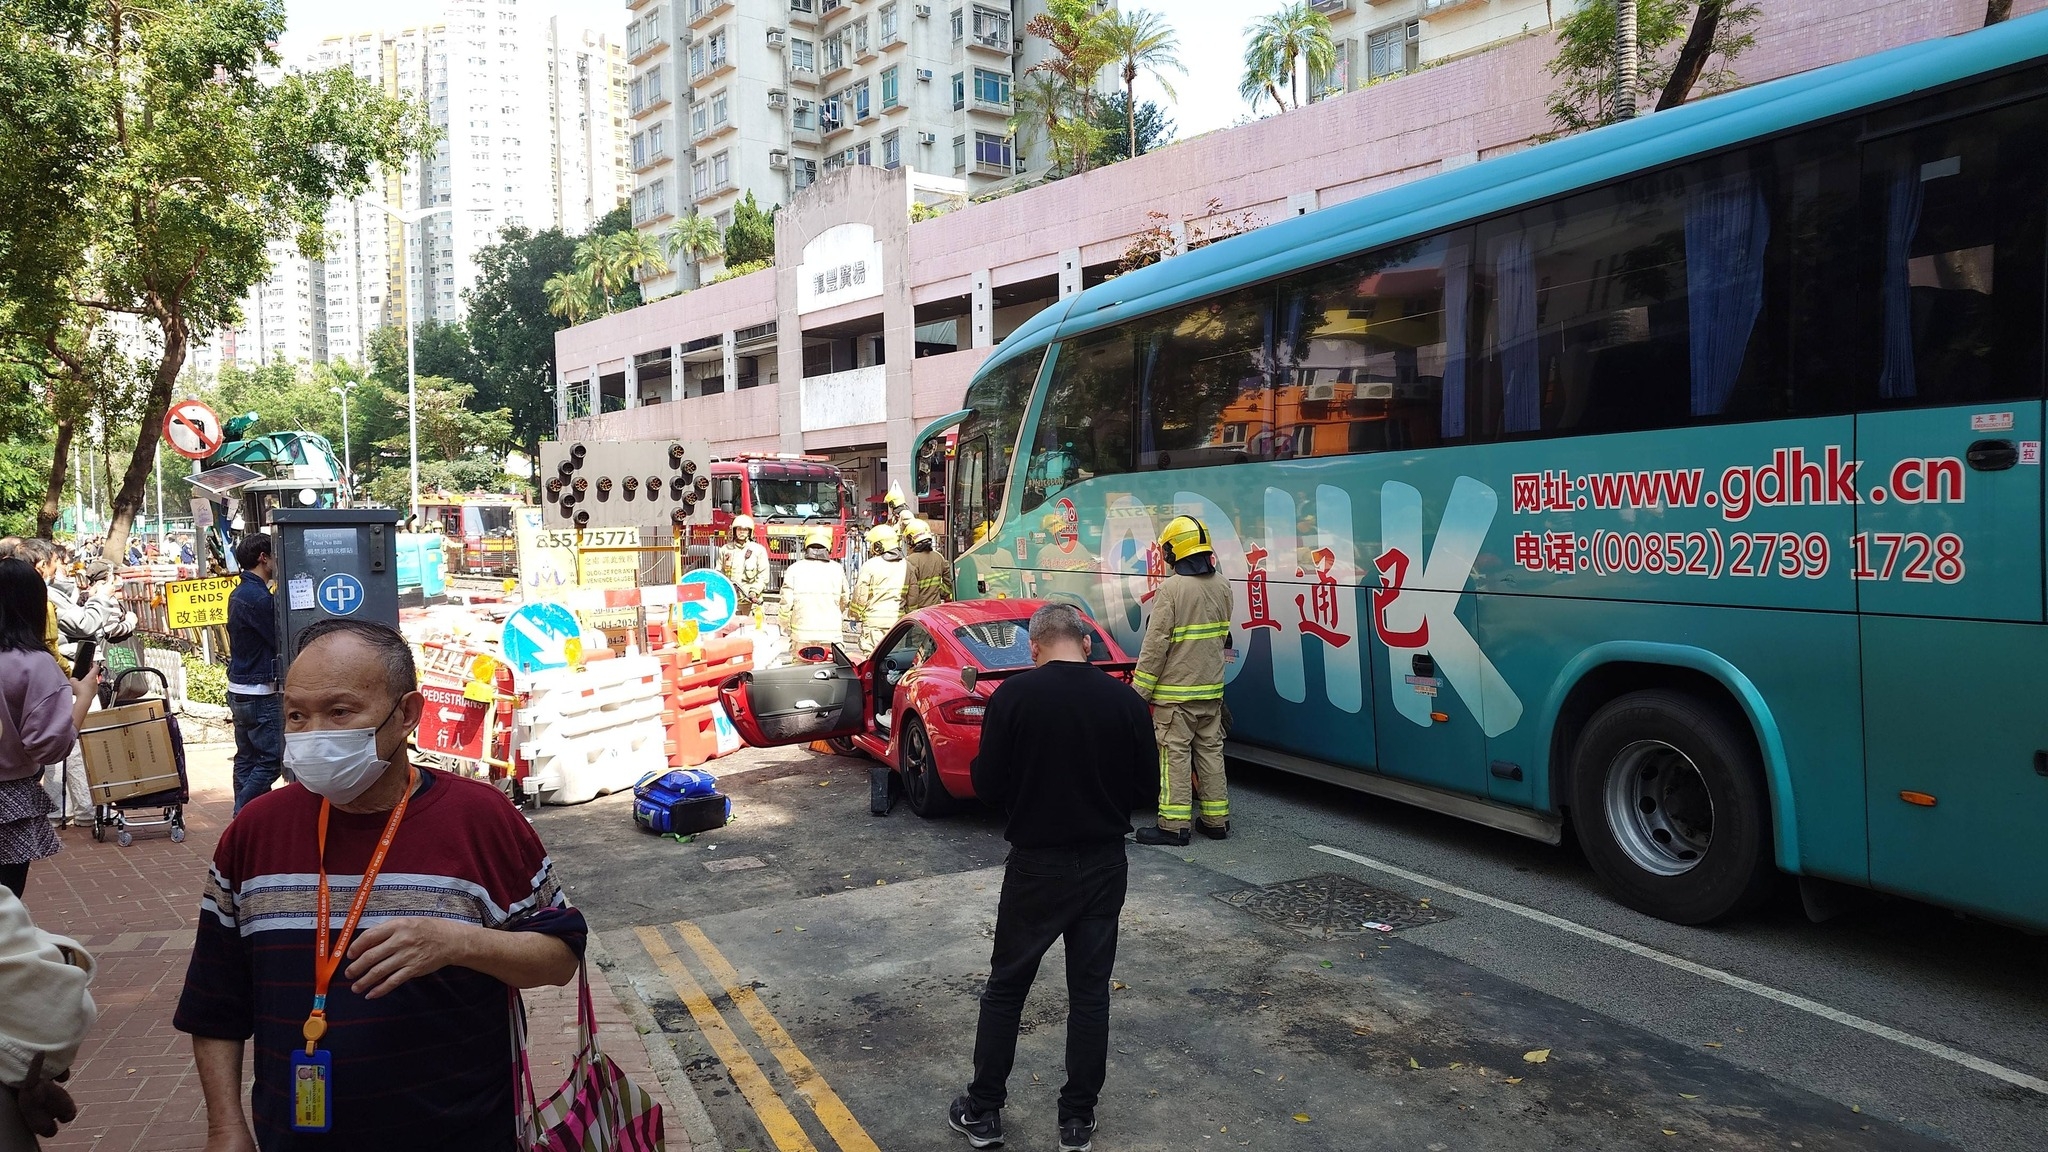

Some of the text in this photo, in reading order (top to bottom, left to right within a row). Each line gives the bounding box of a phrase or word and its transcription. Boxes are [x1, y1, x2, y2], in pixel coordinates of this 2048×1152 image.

[1975, 413, 2011, 424] 太平門
[2024, 449, 2035, 459] 拉
[1850, 531, 1966, 583] 1728
[172, 579, 238, 594] DIVERSION
[190, 592, 224, 604] ENDS
[176, 608, 228, 624] 改道終
[422, 689, 484, 709] PEDESTRIANS
[437, 729, 464, 751] 行人
